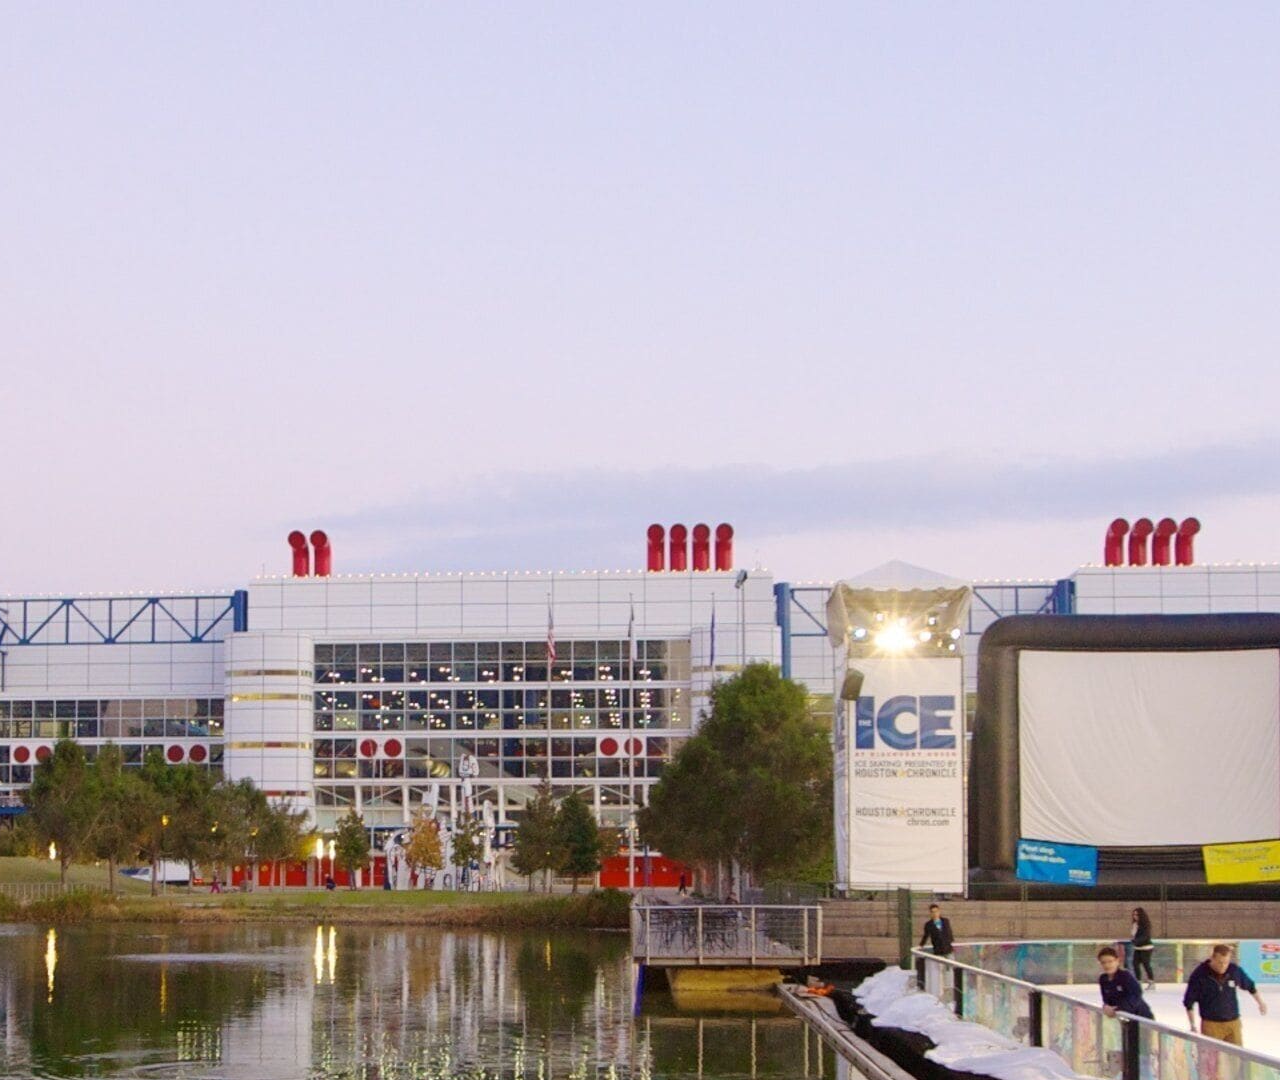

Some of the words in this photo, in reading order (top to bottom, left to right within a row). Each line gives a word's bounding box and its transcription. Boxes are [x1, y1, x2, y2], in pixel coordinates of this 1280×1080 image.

[855, 695, 956, 750] ICE
[869, 760, 901, 768] SKATING
[905, 760, 946, 768] PRESENTED
[855, 768, 898, 778] HOUSTON
[906, 768, 957, 778] CHRONICLE
[855, 807, 898, 817] HOUSTON
[906, 807, 957, 817] CHRONICLE
[906, 818, 950, 826] chron.com
